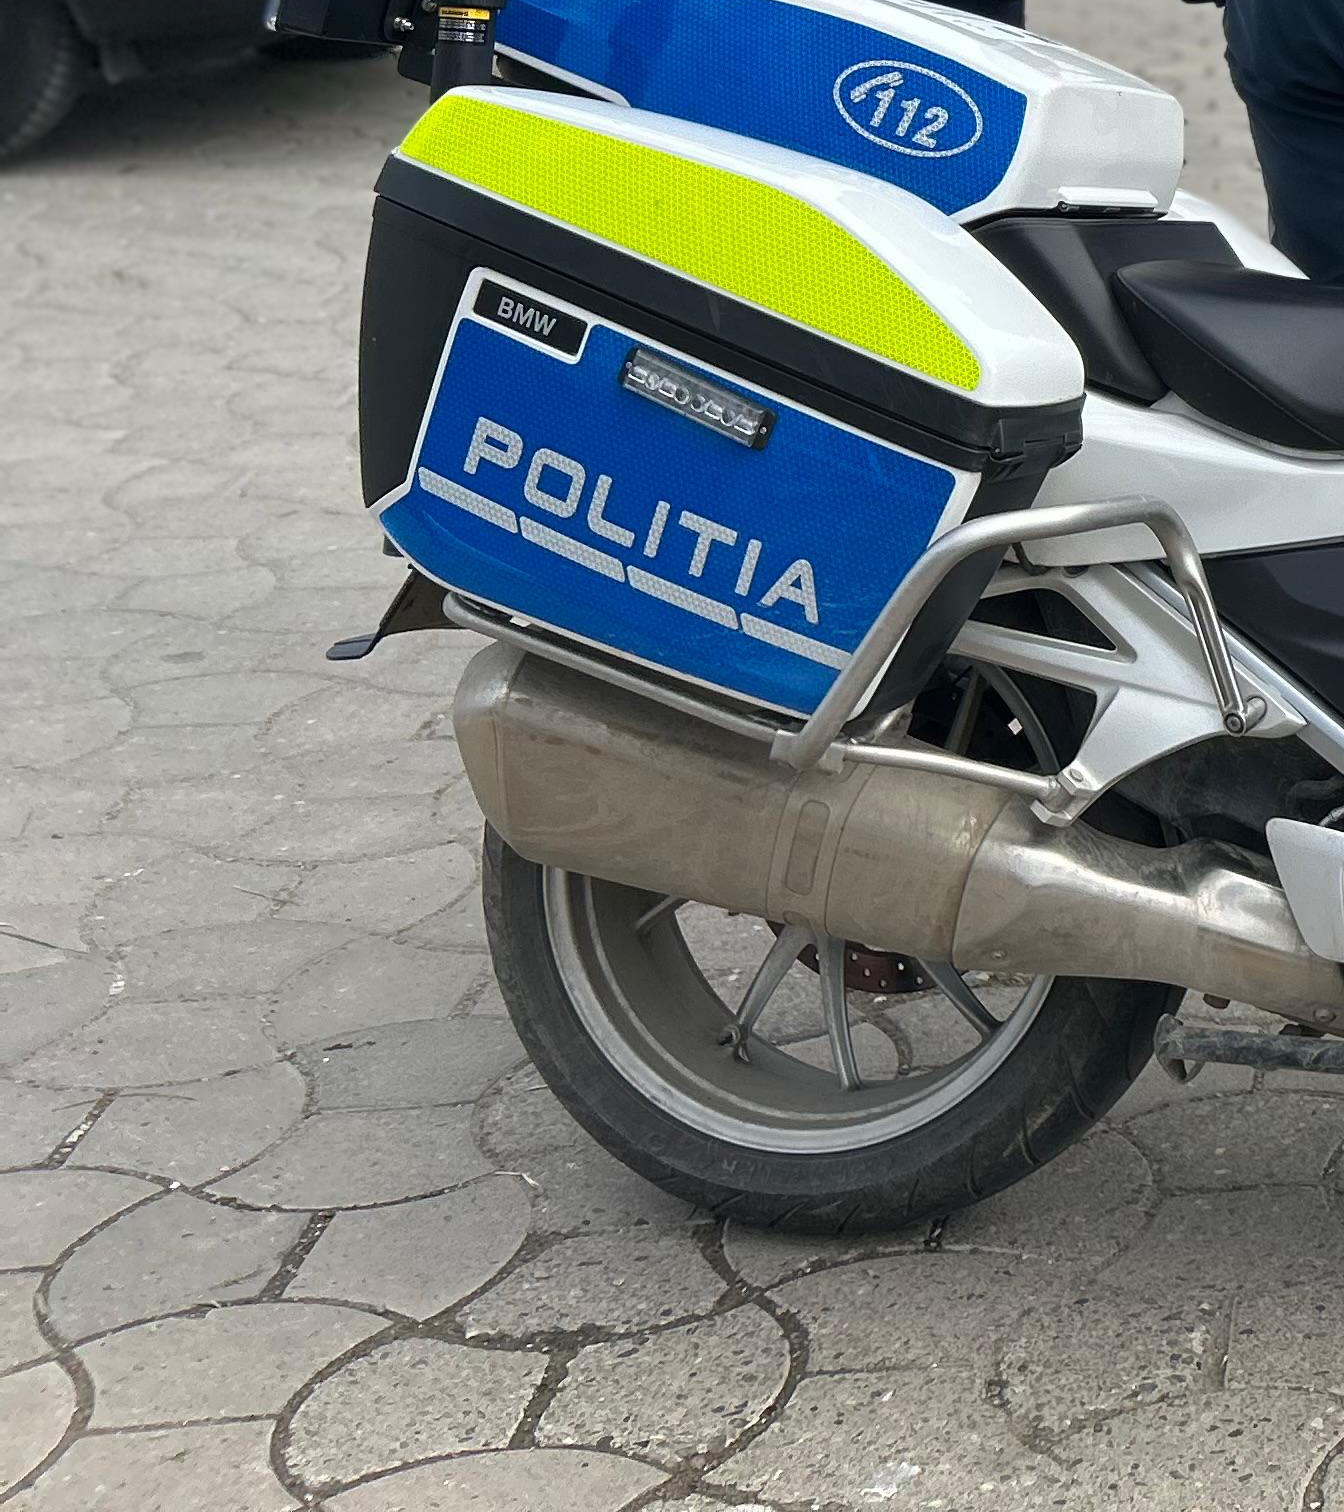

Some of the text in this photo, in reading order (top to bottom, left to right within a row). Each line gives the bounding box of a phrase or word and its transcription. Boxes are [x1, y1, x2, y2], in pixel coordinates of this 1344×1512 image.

[869, 87, 949, 149] 112
[496, 295, 558, 337] BMW
[463, 416, 820, 626] POLITIA
